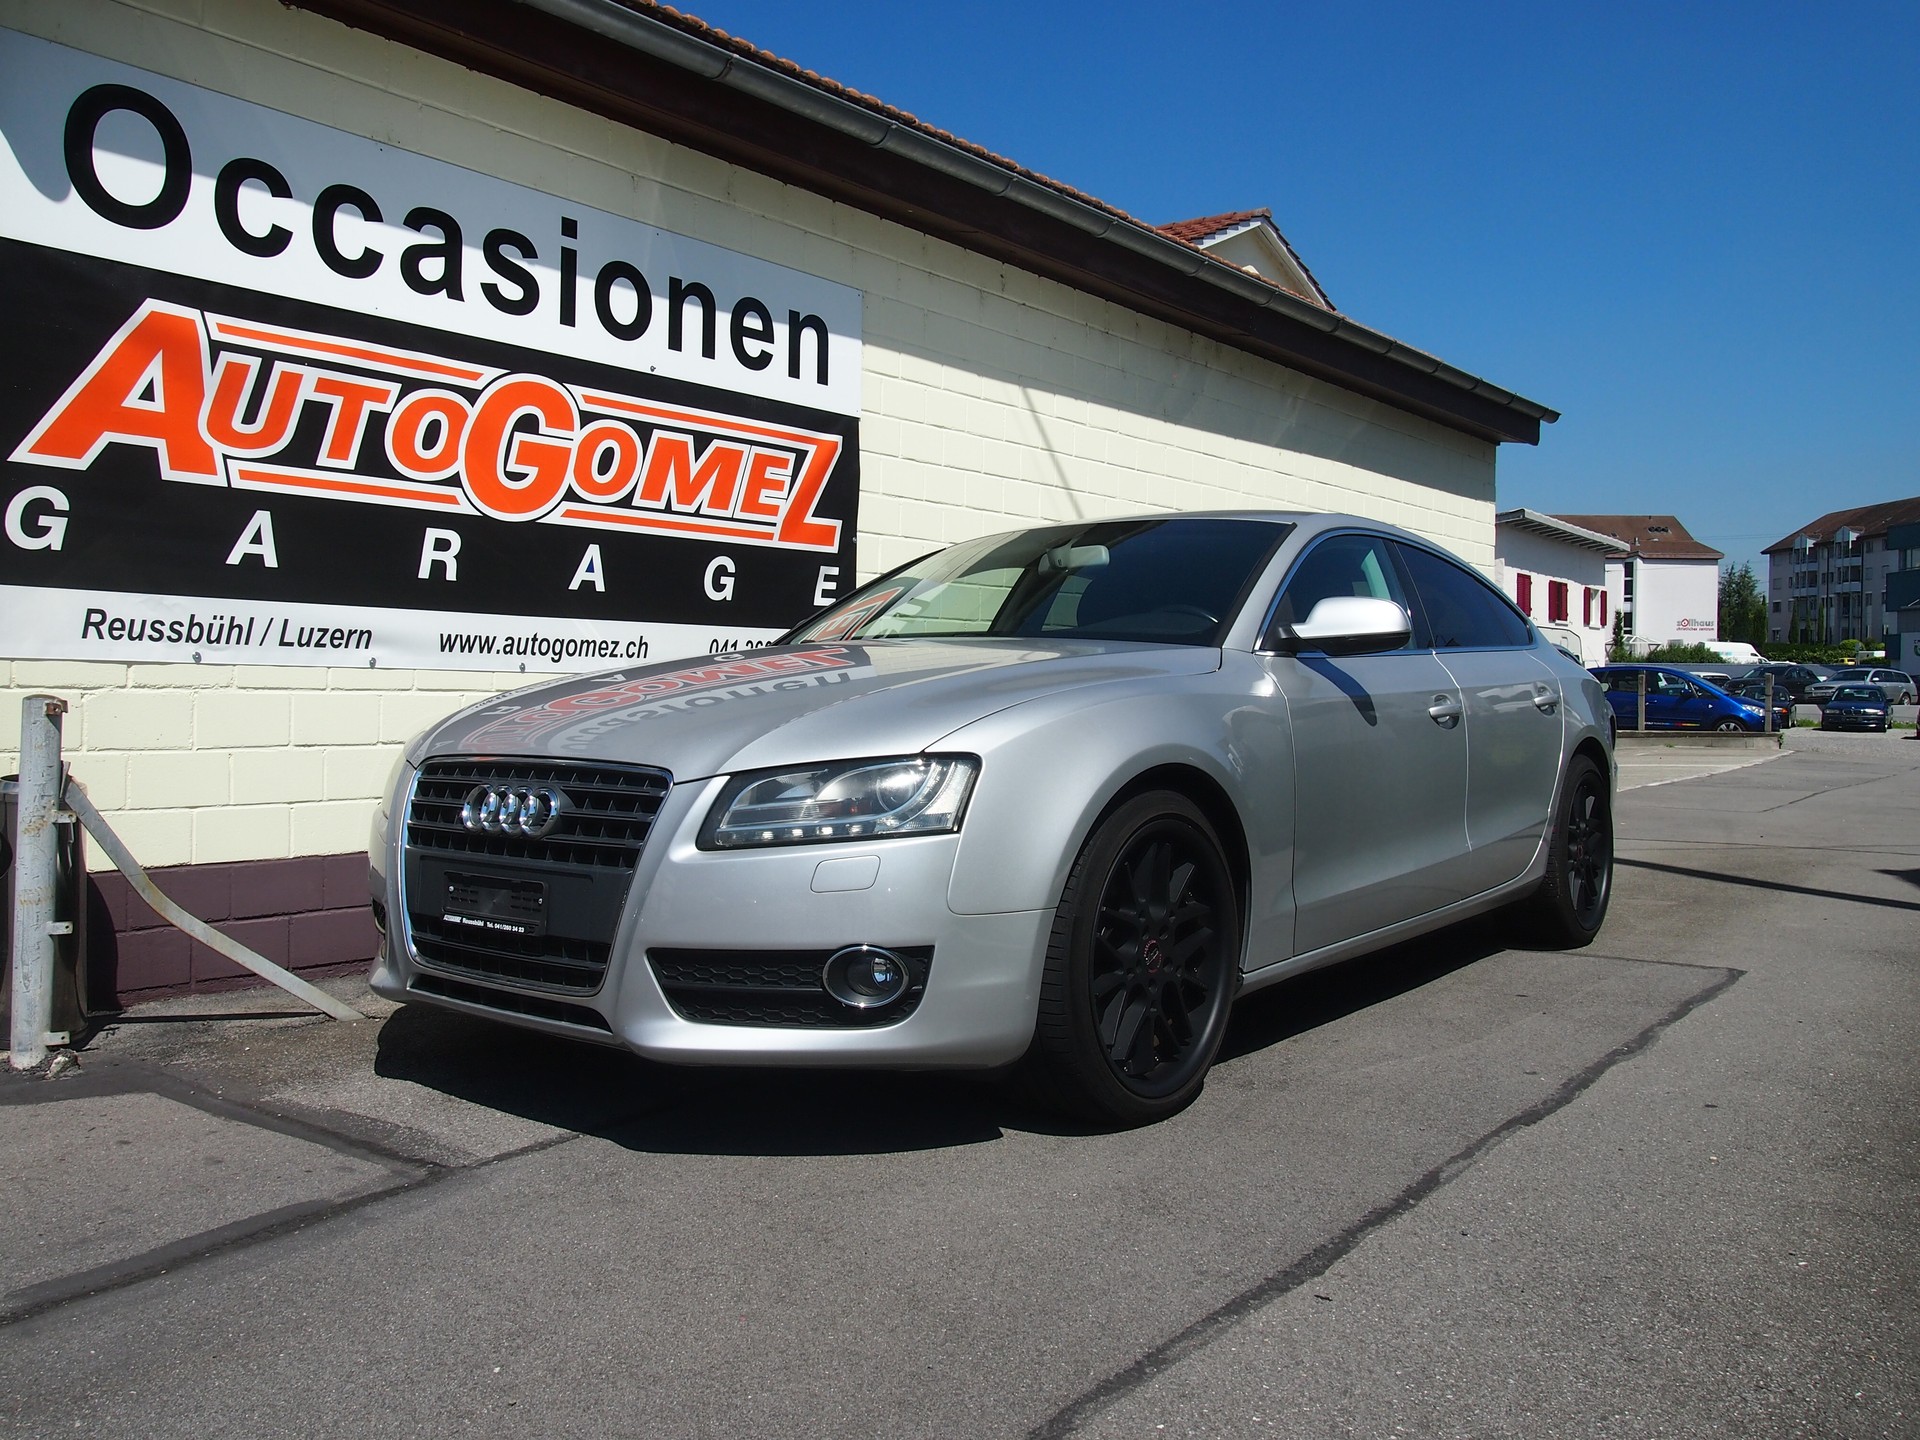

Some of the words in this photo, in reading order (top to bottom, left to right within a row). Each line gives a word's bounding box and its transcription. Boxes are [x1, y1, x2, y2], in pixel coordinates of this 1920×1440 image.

[63, 83, 830, 387] Occasionen
[8, 299, 843, 554] AUTOGOMEZ
[4, 486, 839, 607] GARAGE
[81, 608, 253, 646] Reussbühl
[278, 618, 373, 650] Luzern
[439, 632, 649, 664] www.autogomez.ch
